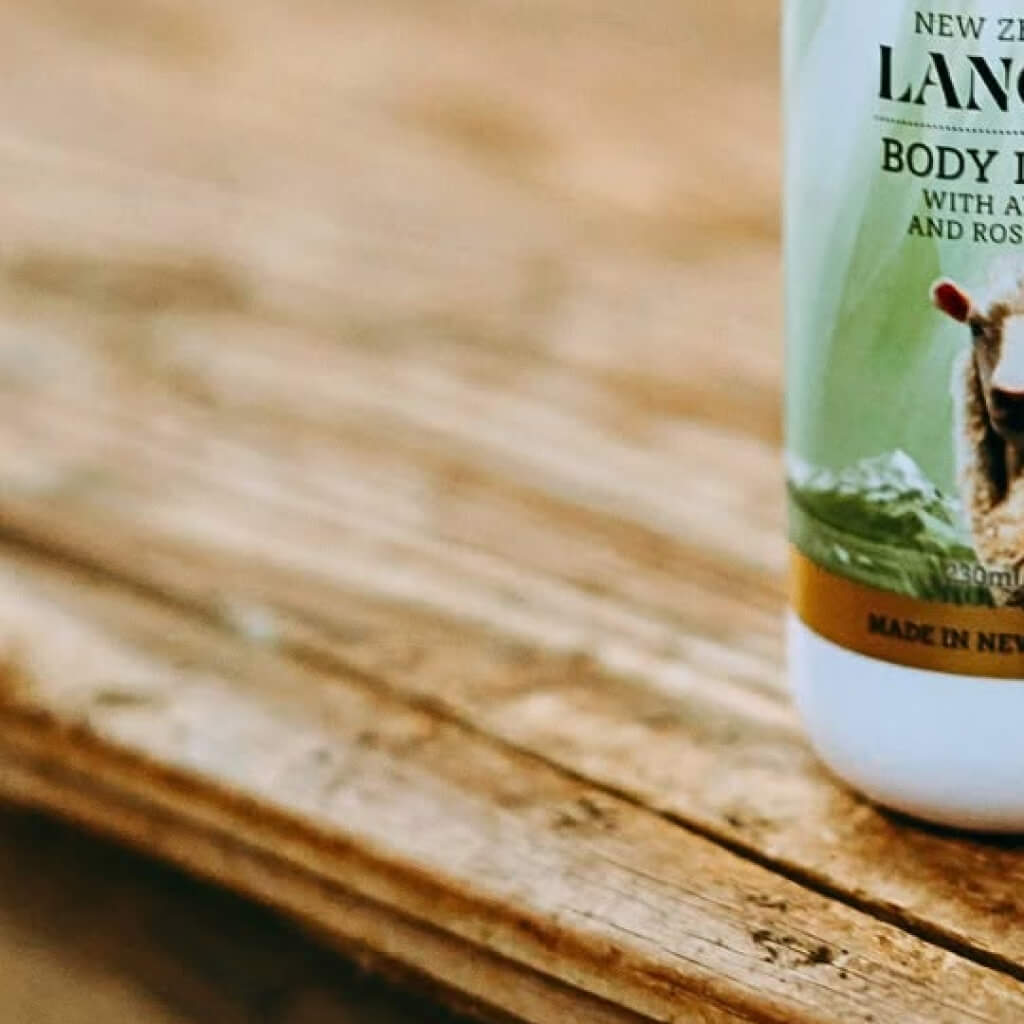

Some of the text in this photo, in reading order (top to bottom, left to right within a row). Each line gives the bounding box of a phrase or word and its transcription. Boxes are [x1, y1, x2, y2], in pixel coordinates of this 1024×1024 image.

[914, 11, 985, 40] NEW
[881, 137, 998, 183] BODY
[921, 189, 994, 215] WITH
[907, 215, 964, 241] AND
[867, 612, 934, 641] MADE
[942, 626, 970, 649] IN
